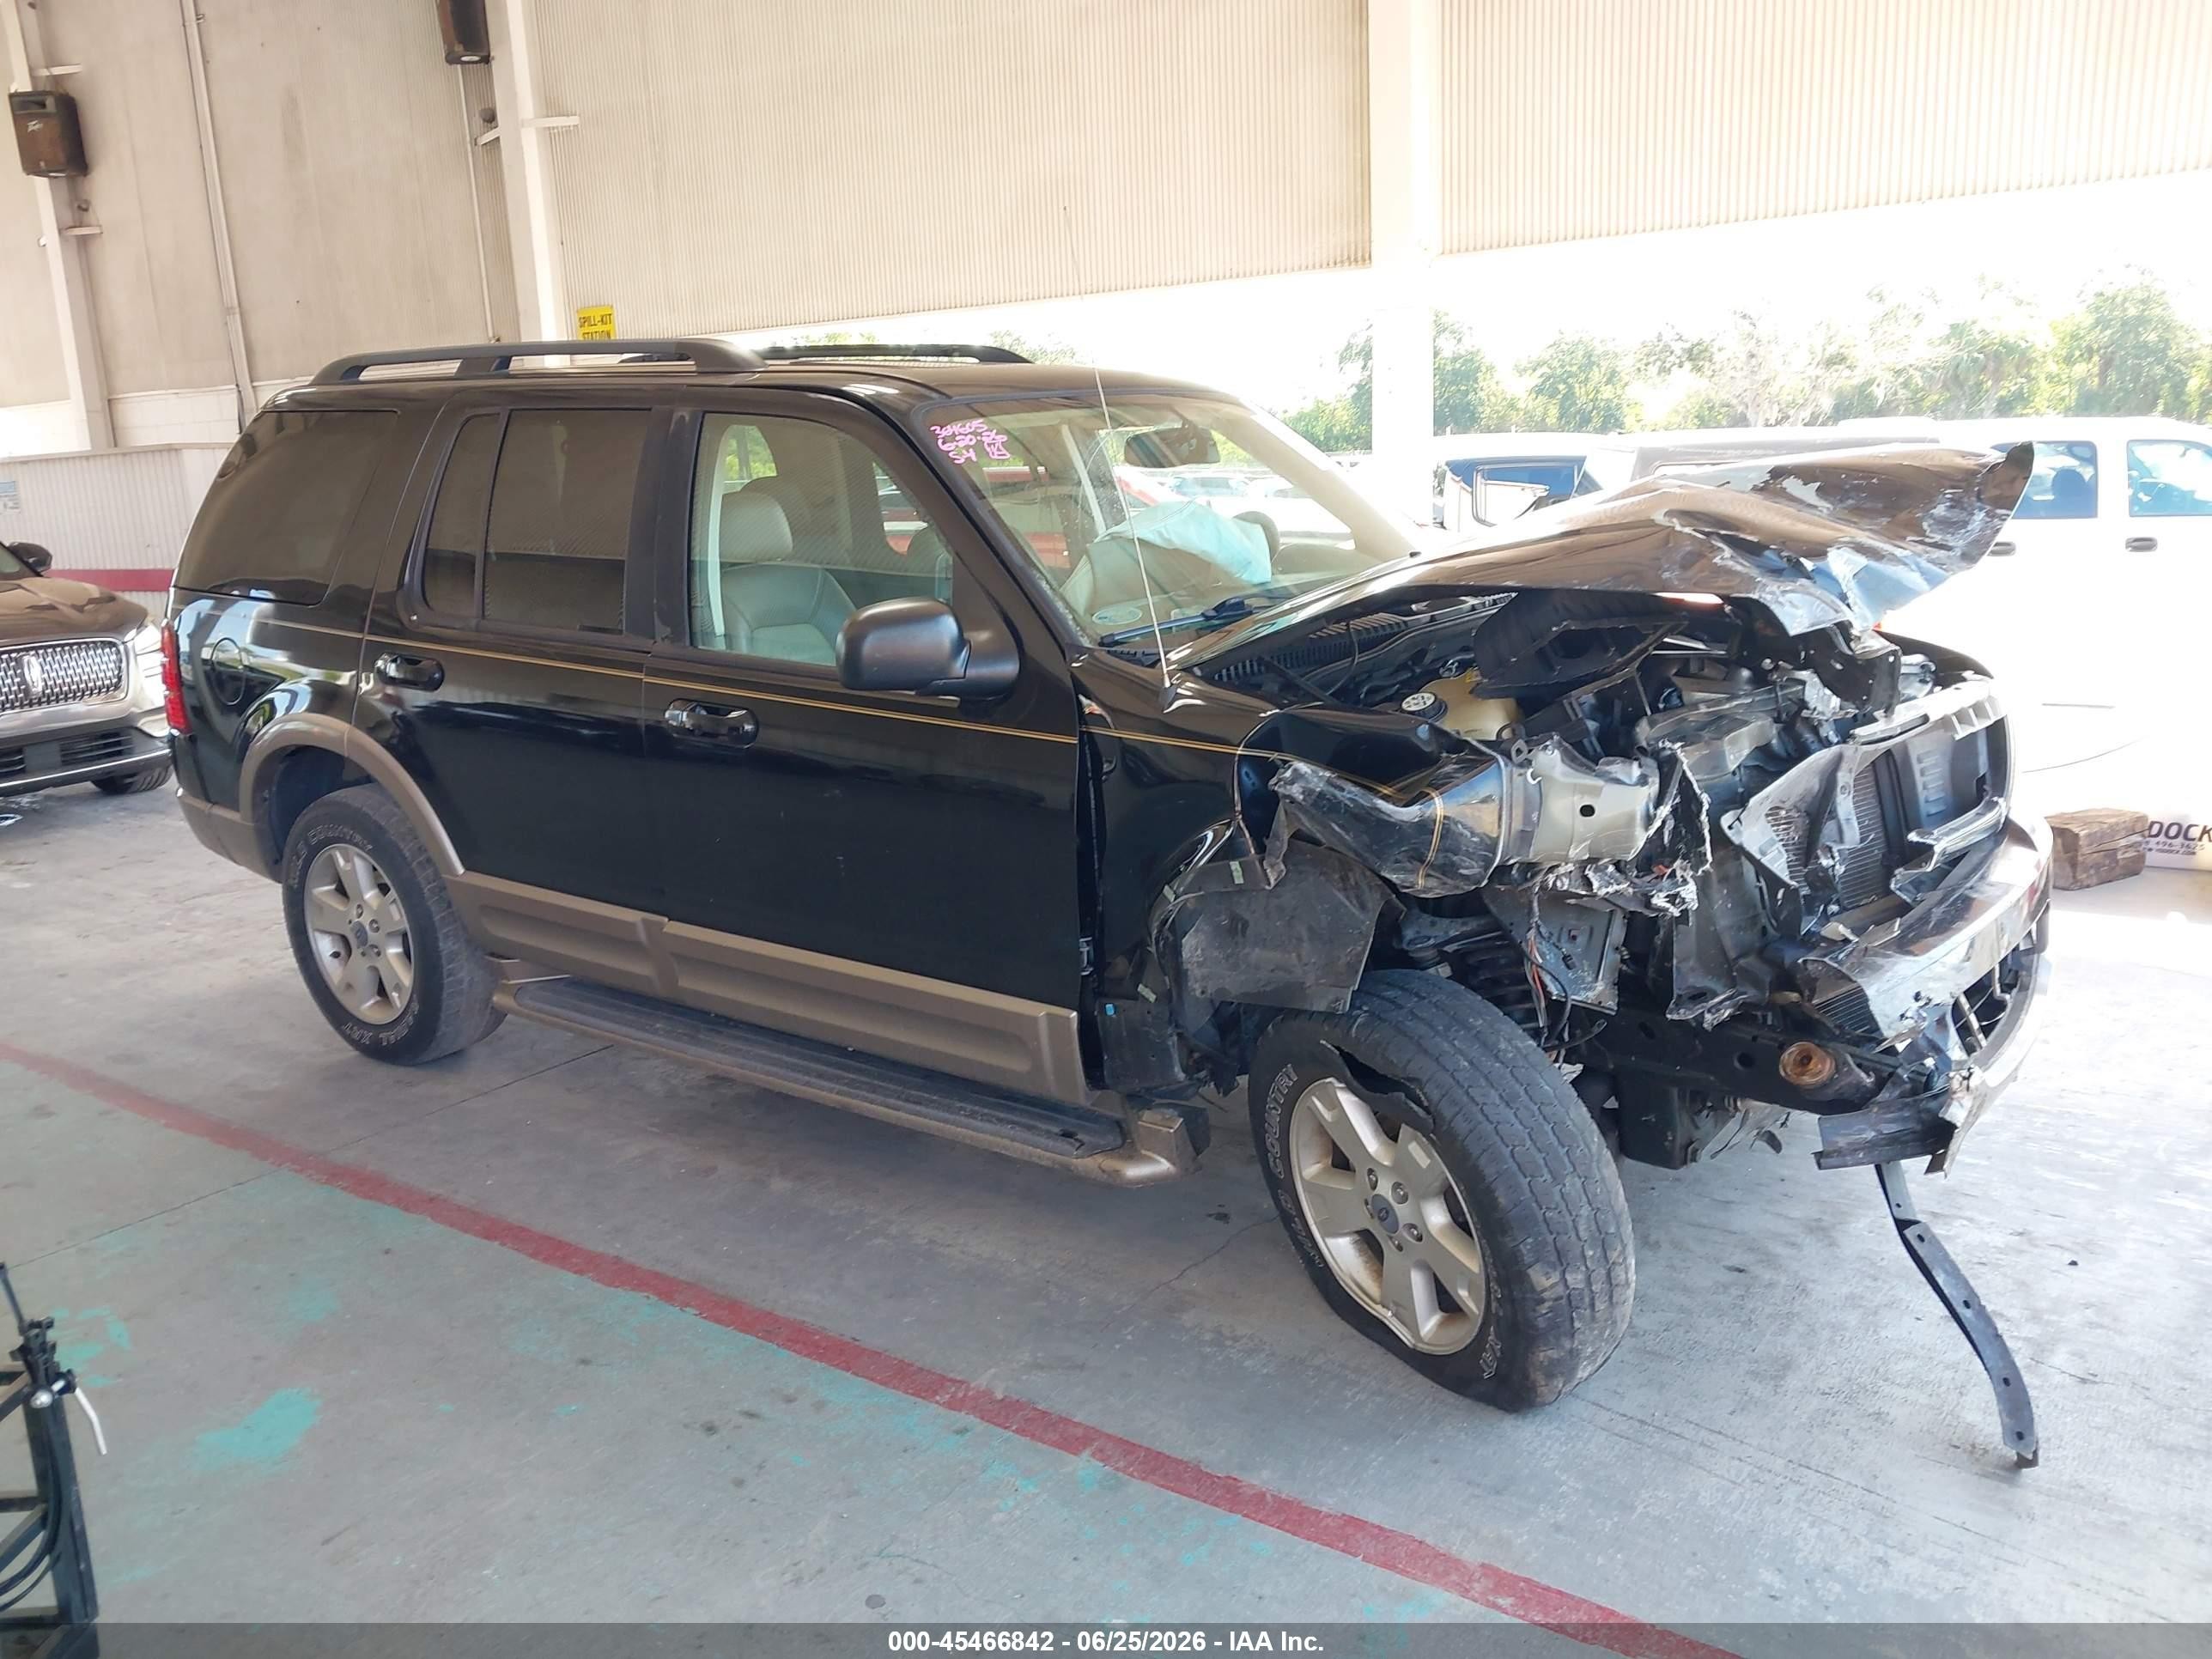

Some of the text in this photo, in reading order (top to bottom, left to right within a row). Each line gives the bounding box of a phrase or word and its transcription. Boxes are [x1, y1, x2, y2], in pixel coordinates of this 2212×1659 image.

[579, 313, 612, 328] SPILL-KIT
[2148, 820, 2212, 842] DOCK
[1264, 1063, 1298, 1179] COUNTRY
